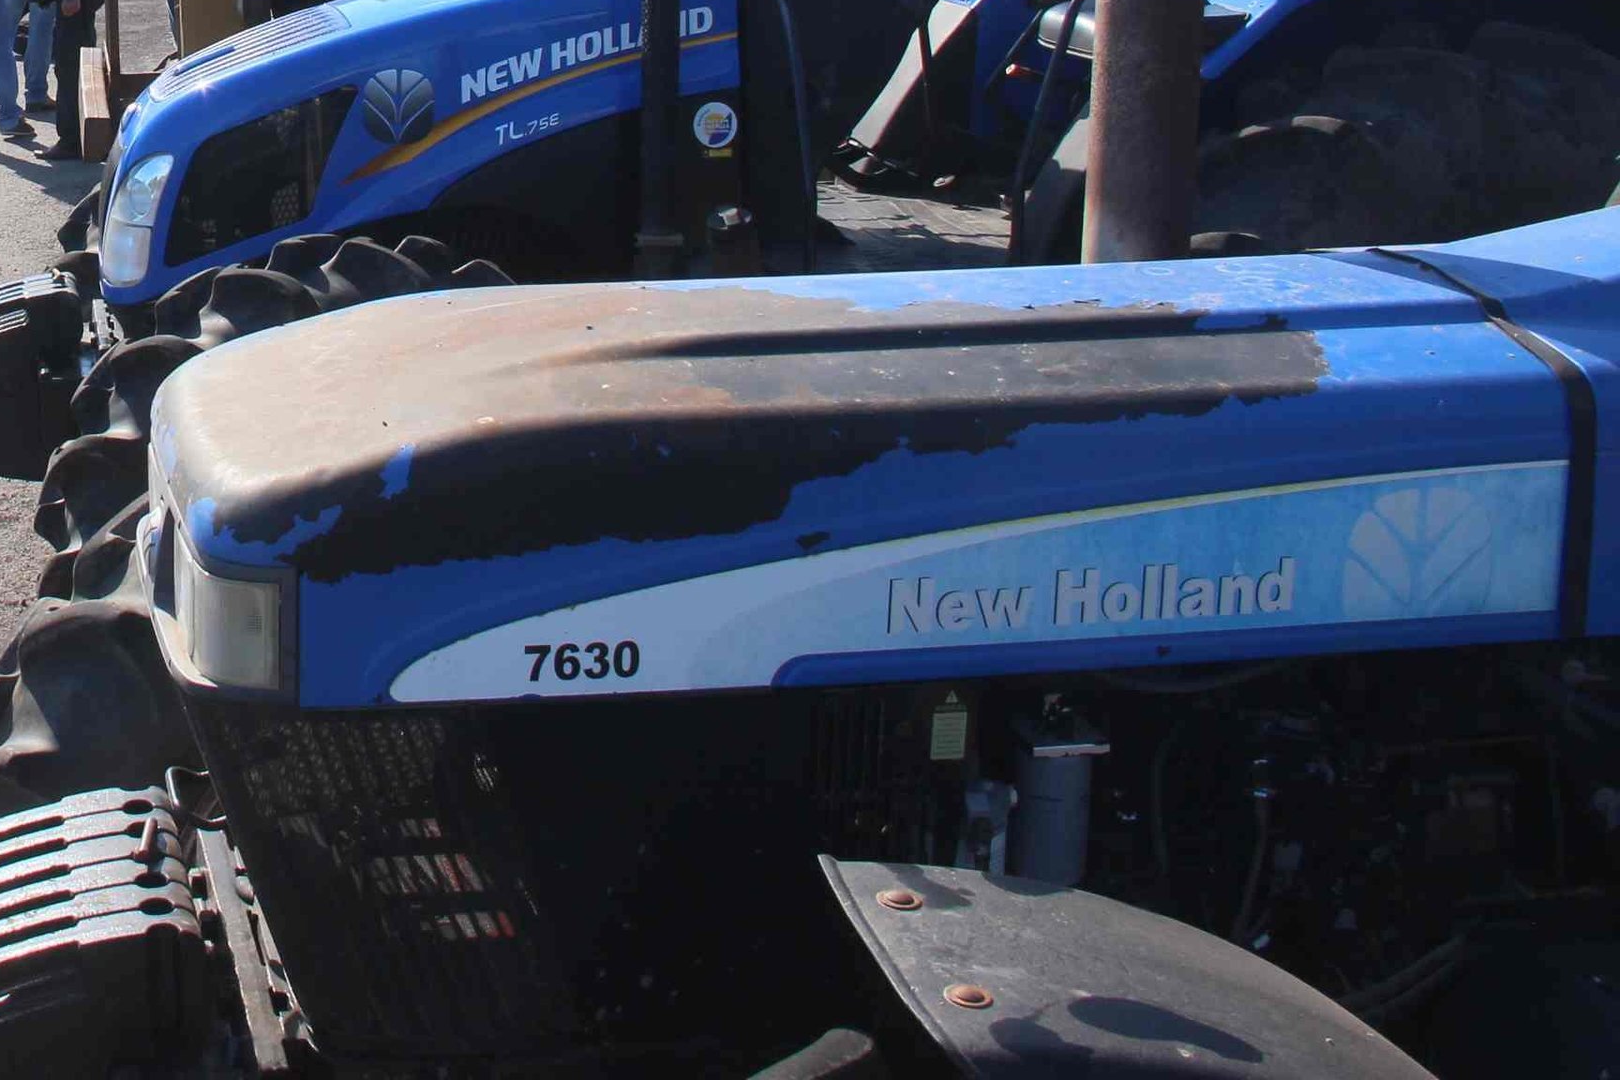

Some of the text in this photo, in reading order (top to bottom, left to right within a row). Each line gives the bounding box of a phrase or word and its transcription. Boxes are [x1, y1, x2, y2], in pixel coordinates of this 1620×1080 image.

[461, 6, 714, 104] NEW HOLLD
[886, 555, 1298, 635] New Holland
[524, 640, 640, 682] 7630
